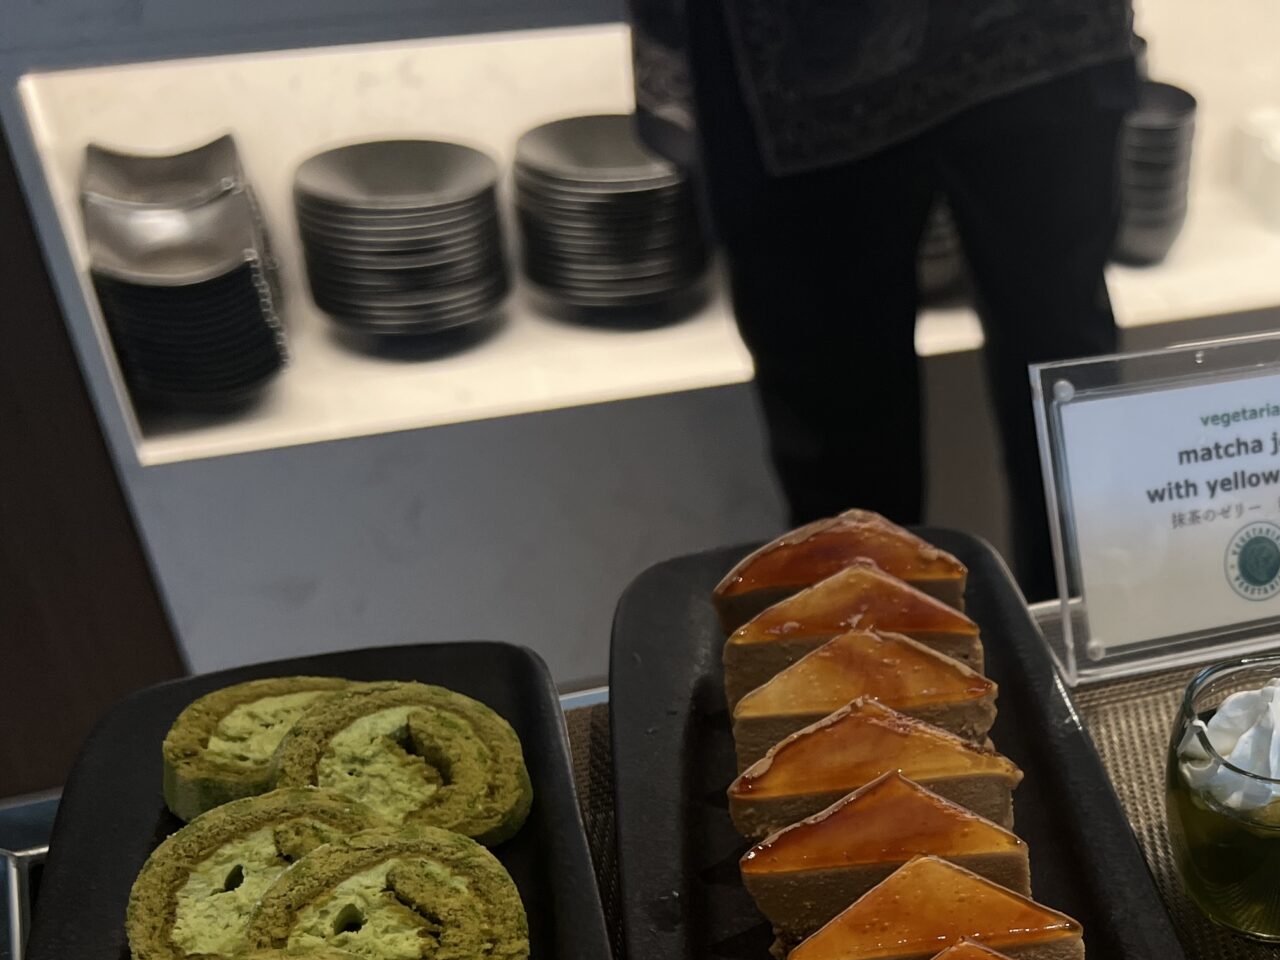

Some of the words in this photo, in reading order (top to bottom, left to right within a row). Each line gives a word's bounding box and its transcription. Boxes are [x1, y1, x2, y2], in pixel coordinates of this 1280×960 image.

[1178, 437, 1263, 465] matcha
[1146, 479, 1198, 504] with
[1205, 470, 1280, 498] yellow
[1171, 503, 1261, 529] 抹茶のゼリー
